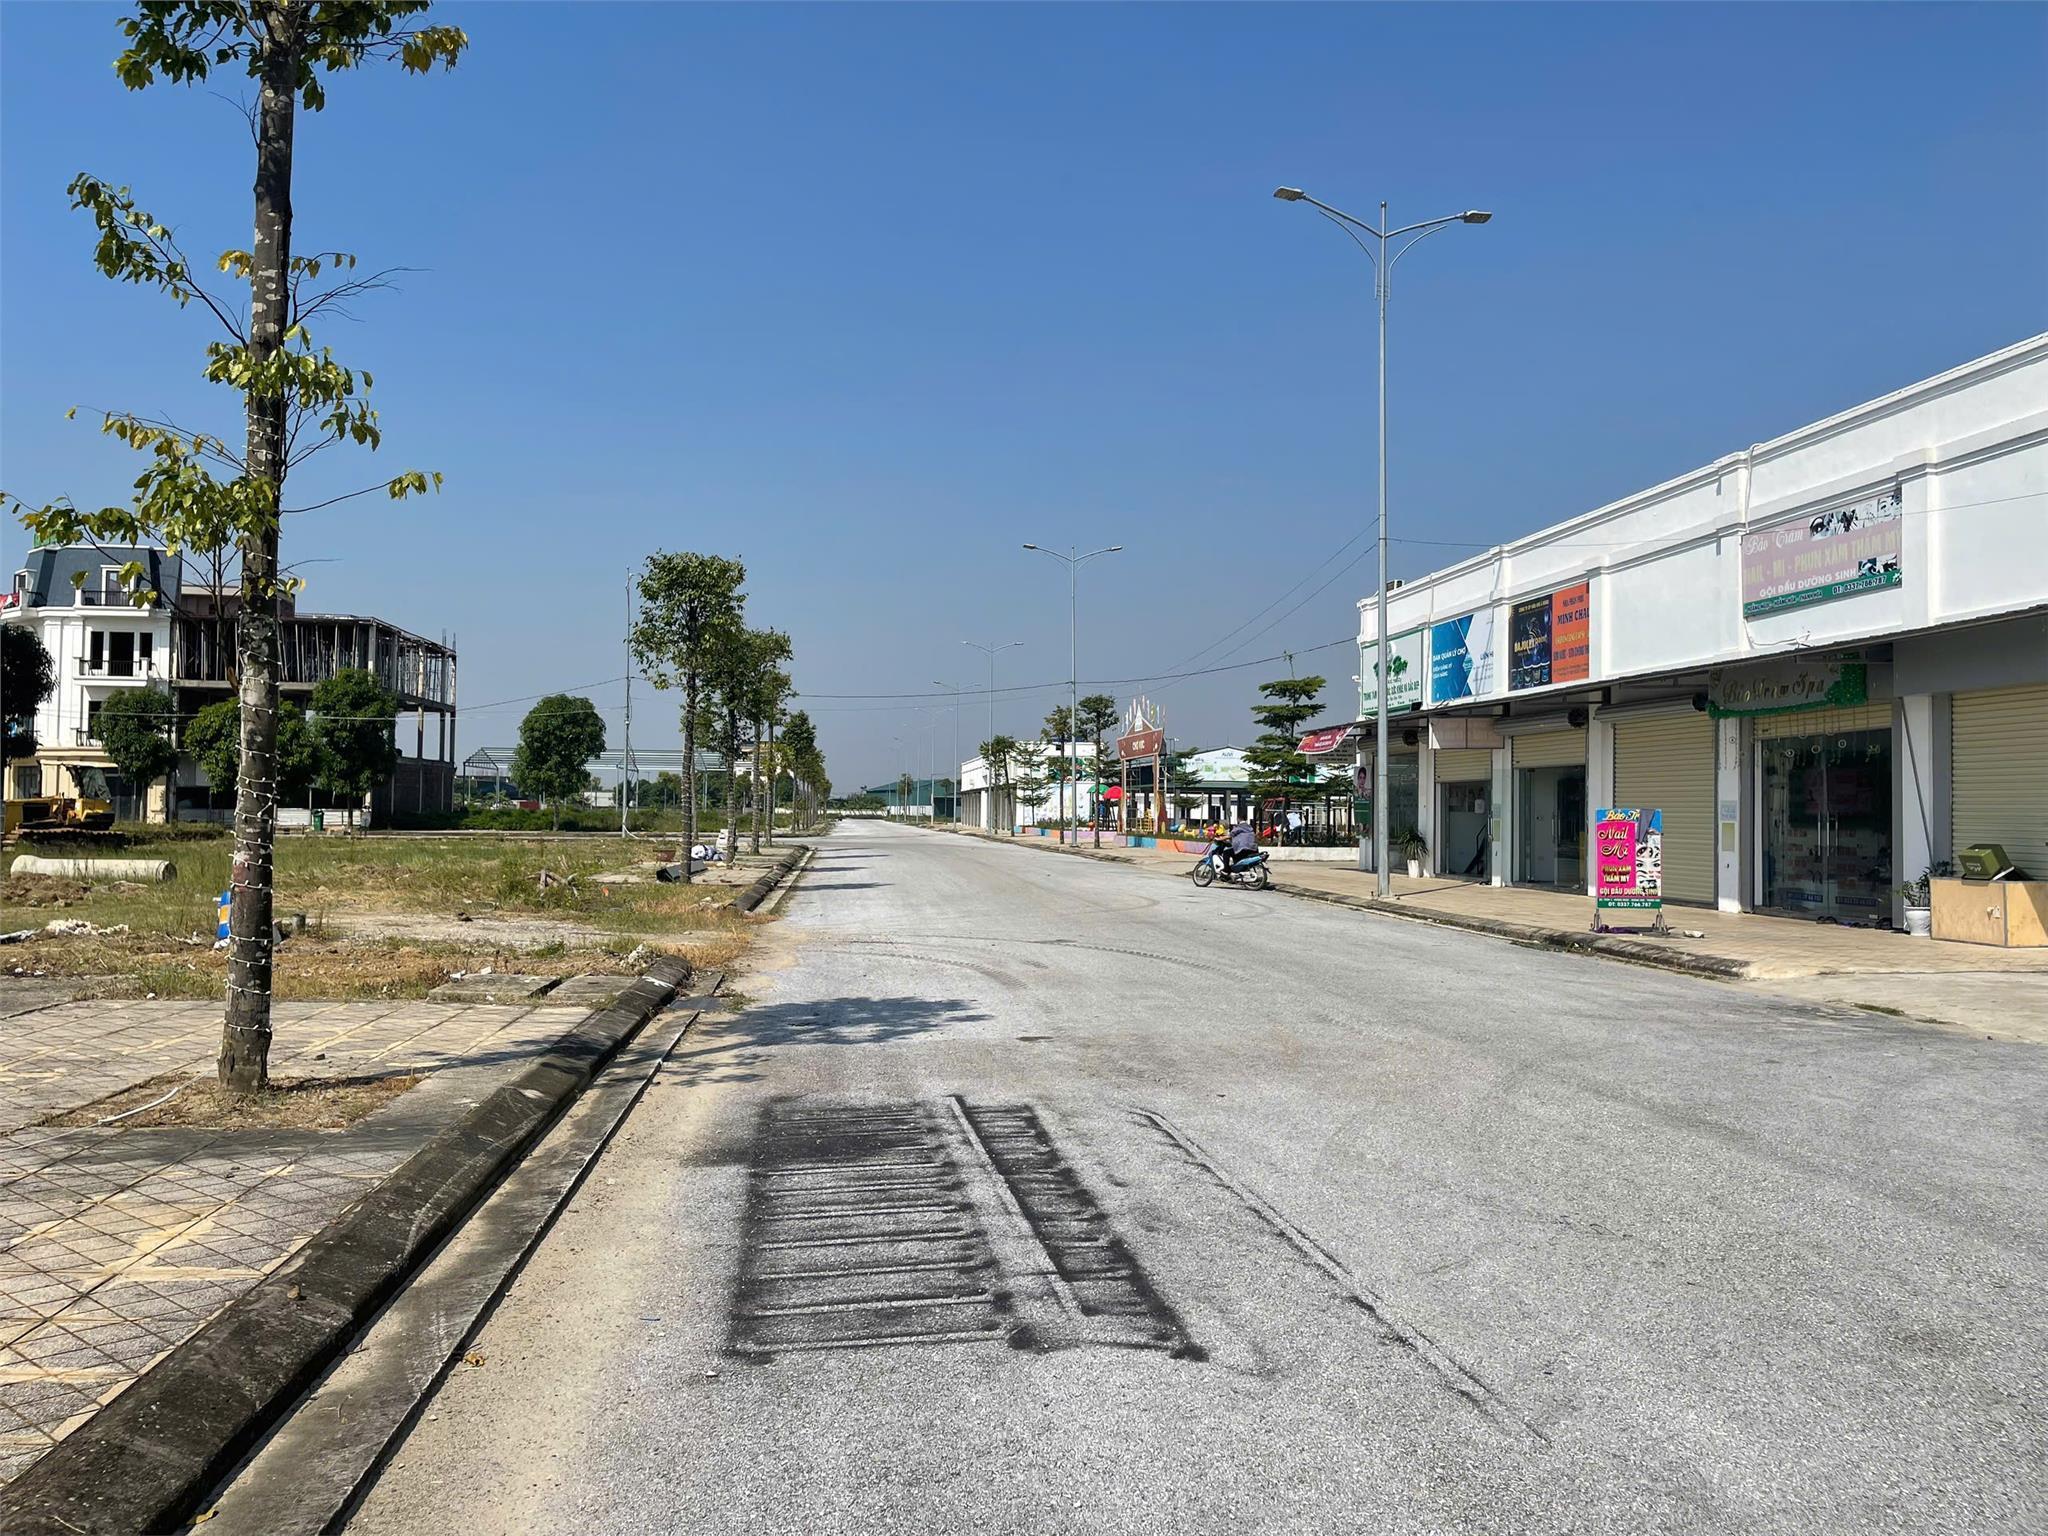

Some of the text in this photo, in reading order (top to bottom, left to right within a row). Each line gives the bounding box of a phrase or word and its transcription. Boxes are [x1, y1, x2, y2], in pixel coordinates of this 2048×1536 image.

[1835, 568, 1857, 580] SINH
[1558, 610, 1574, 625] MINH
[1598, 825, 1629, 840] Nail
